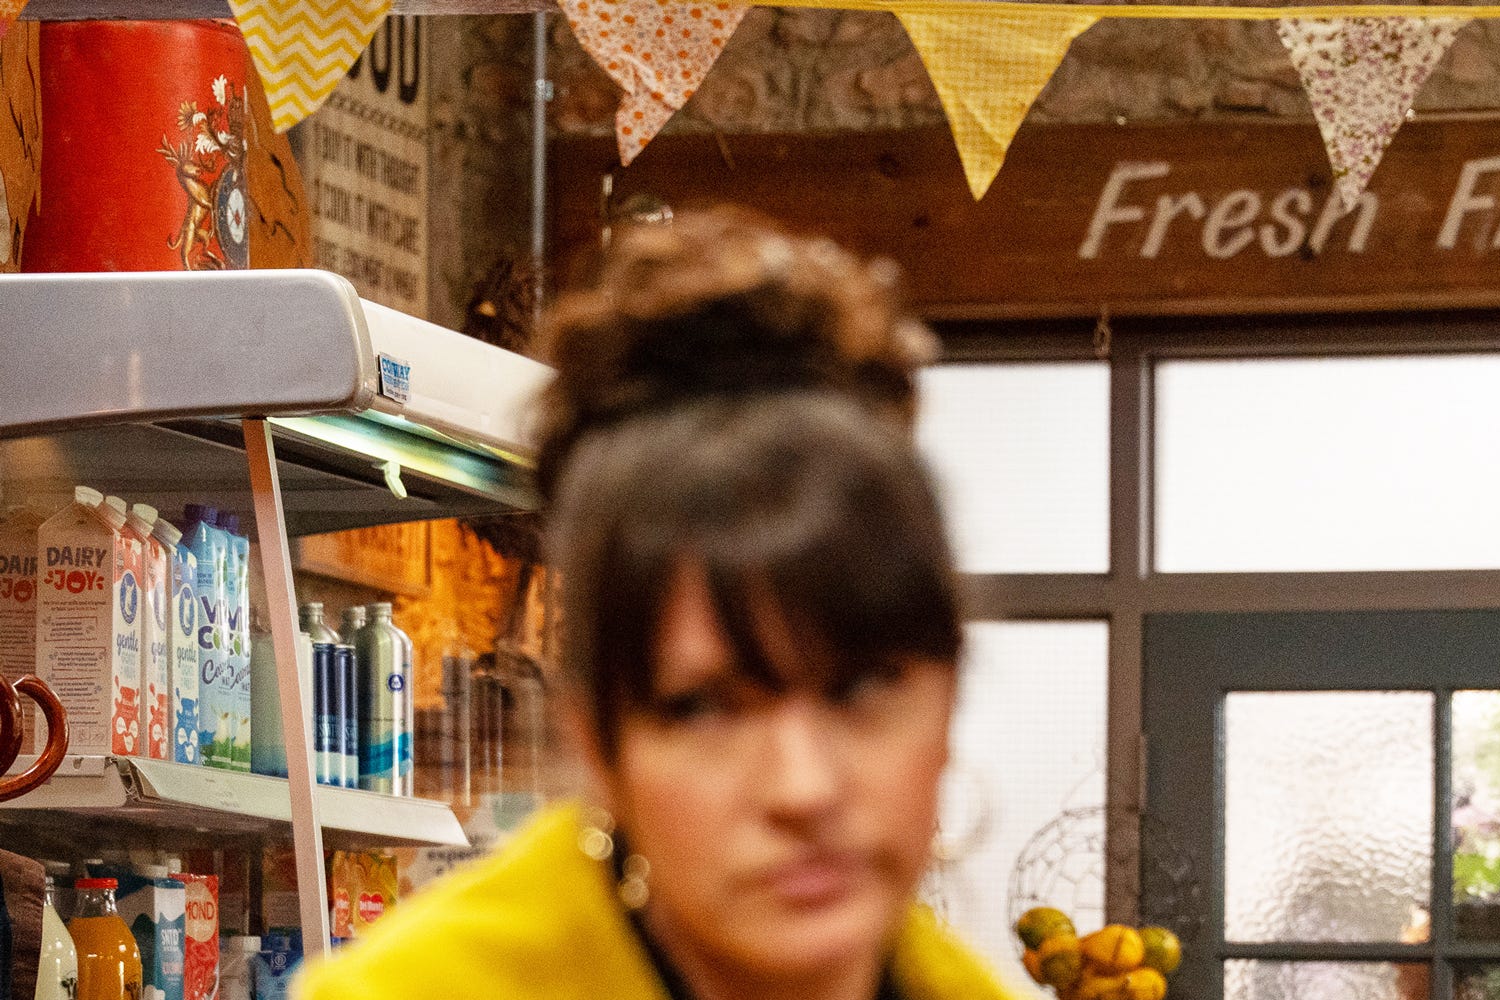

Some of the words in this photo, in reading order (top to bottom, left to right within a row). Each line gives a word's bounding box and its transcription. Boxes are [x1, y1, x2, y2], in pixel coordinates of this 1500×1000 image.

[1078, 161, 1378, 258] Fresh
[46, 546, 107, 568] DAIRY
[53, 569, 98, 594] JOY
